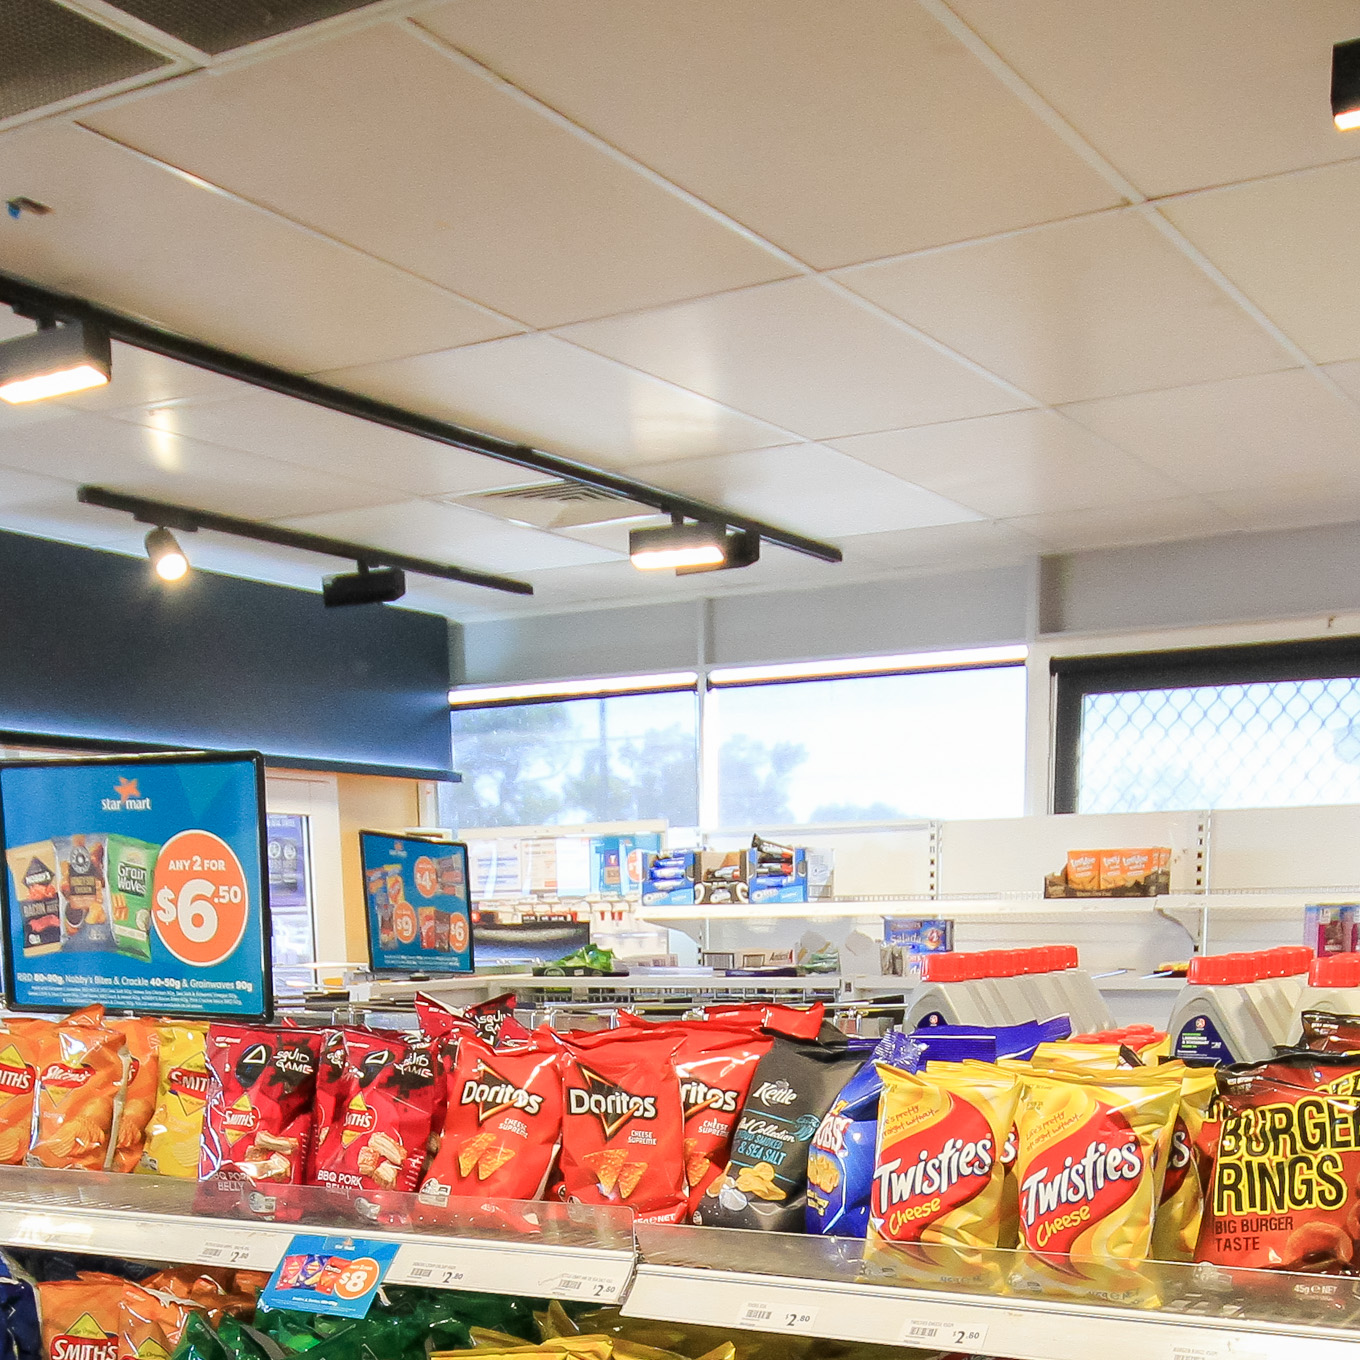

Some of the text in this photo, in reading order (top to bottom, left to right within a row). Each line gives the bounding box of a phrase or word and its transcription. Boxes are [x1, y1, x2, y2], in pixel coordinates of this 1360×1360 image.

[101, 798, 151, 810] star mart
[168, 856, 225, 871] ANY 2 FOR
[236, 980, 253, 992] 90g
[461, 1079, 544, 1115] Doritos
[753, 1079, 797, 1106] Kettle
[569, 1088, 658, 1119] Doritos
[222, 1109, 255, 1128] SMITH'S
[504, 1116, 527, 1130] CHEESE
[630, 1129, 654, 1139] CHEESE
[748, 1120, 795, 1142] Collection
[627, 1136, 658, 1146] SUPREME
[755, 1133, 784, 1149] SMOKED
[737, 1142, 787, 1166] & SEA SALT
[317, 1169, 363, 1188] BBQ PORK
[873, 1135, 995, 1214] Twisties
[1021, 1141, 1142, 1226] Twisties
[1213, 1151, 1348, 1217] RINGS
[218, 1180, 245, 1192] BELLY
[888, 1197, 942, 1237] Cheese
[1035, 1204, 1091, 1248] Cheese
[1214, 1216, 1294, 1234] BIG BURGER
[1214, 1237, 1260, 1253] TASTE
[341, 1268, 368, 1292] $8
[785, 1312, 810, 1328] $2.80
